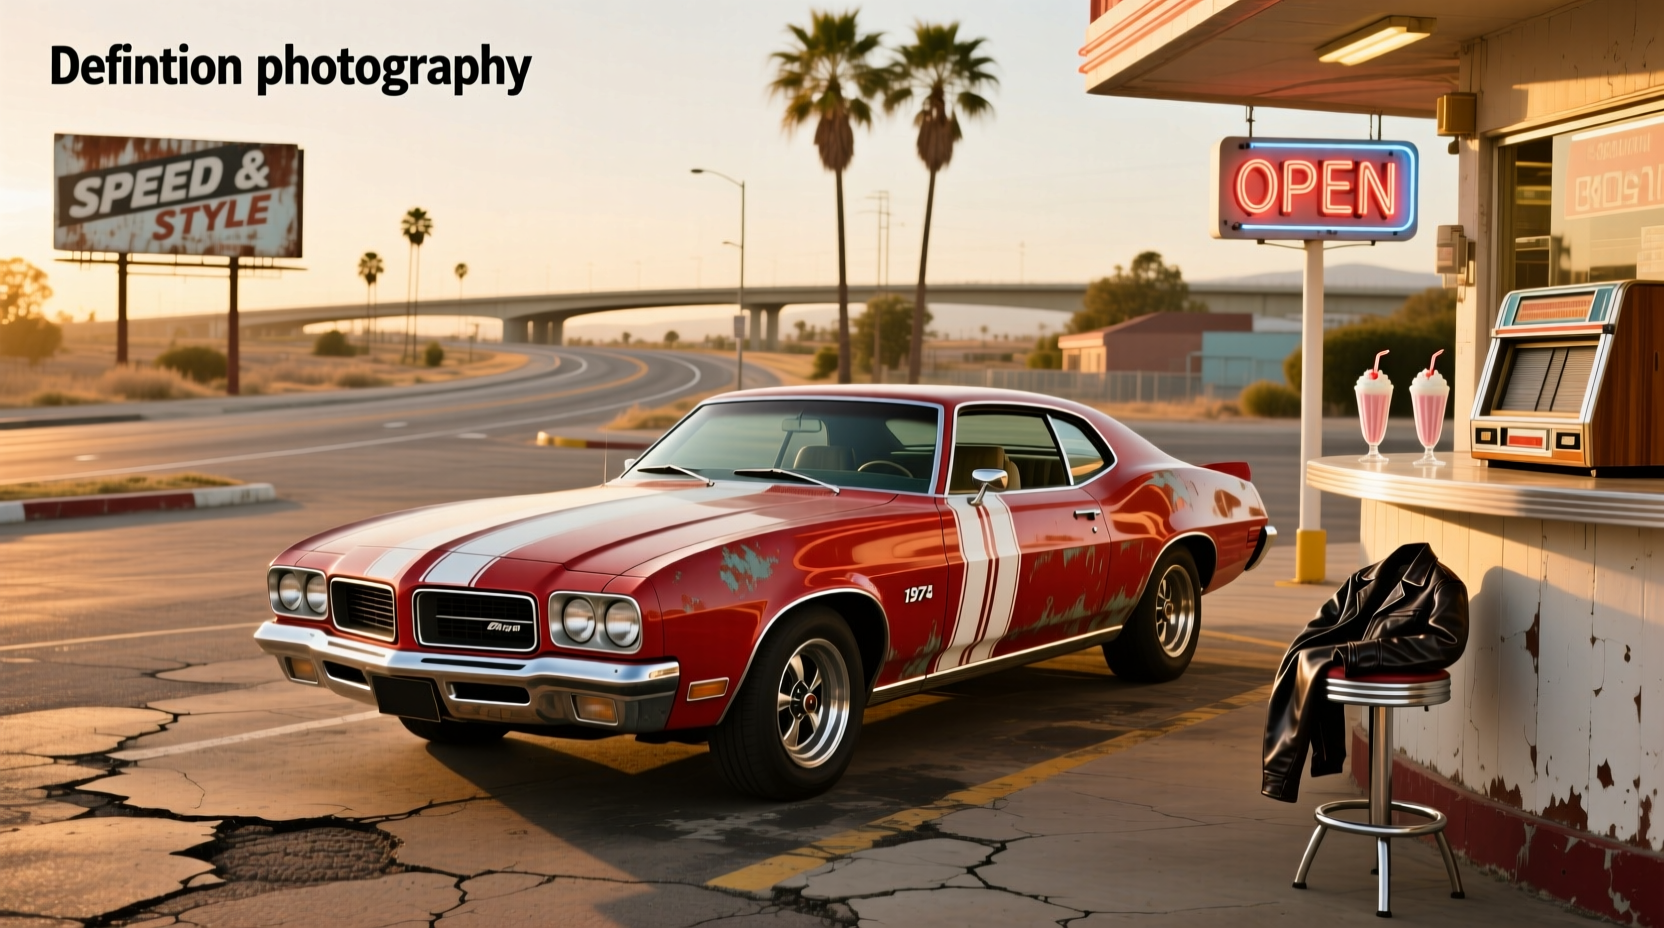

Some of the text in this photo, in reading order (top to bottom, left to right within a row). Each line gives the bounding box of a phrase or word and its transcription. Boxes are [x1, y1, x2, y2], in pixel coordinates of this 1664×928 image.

[68, 149, 270, 219] SPEED &
[1235, 158, 1396, 216] OPEN
[152, 193, 272, 242] STYLE
